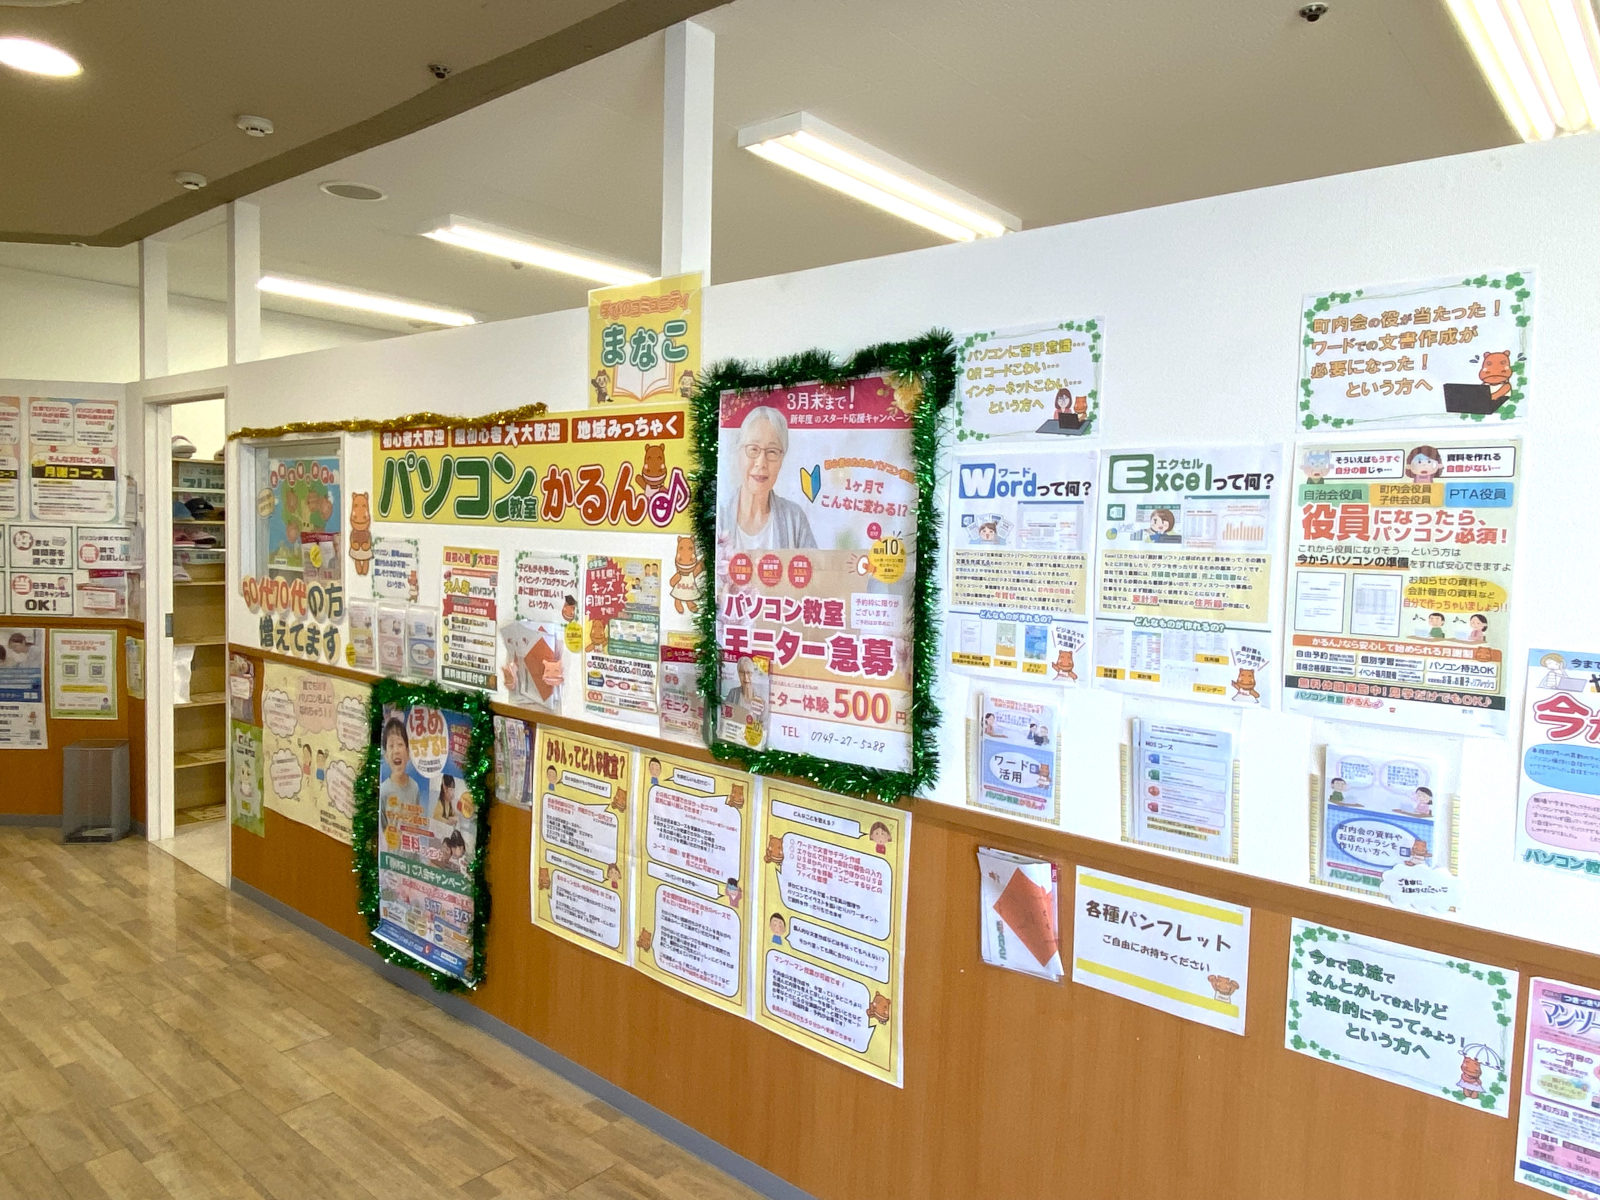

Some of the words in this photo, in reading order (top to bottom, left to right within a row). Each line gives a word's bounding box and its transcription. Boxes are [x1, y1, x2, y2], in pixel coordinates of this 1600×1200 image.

[1313, 299, 1501, 334] 町内会の役が当たった!
[601, 322, 688, 371] まなこ
[1311, 325, 1479, 356] ワードでの文書作成が
[967, 338, 1086, 362] パソコンに苦手意識…
[1310, 353, 1429, 379] 必要になった!
[966, 378, 1082, 398] インターネットこわい…
[1345, 378, 1433, 399] という方へ
[786, 385, 855, 411] 3月末まで!
[988, 398, 1045, 415] という方へ
[576, 415, 679, 441] 地域みっちゃく
[1157, 458, 1203, 470] エクセル
[1335, 454, 1401, 465] そういえばもうすぐ
[1446, 453, 1502, 462] 資料を作れる
[998, 467, 1031, 478] ワード
[378, 451, 537, 522] パソコン
[1303, 489, 1363, 501] 自治会役員
[1380, 484, 1432, 494] 町内会役員
[1449, 489, 1506, 501] PTA役員
[508, 495, 538, 521] 教室
[821, 494, 909, 518] こんなに変わる!?
[1380, 495, 1431, 505] 子供会役員
[1302, 504, 1370, 542] 役員
[1373, 509, 1490, 527] になったら、
[1373, 527, 1508, 545] パソコン必須!
[1298, 544, 1462, 557] これから役員になりそう…という方は
[1297, 554, 1511, 572] 今からパソコンの準備をすれば安心できますよ
[592, 578, 616, 595] キッズ
[1408, 576, 1488, 588] お知らせの資料や
[242, 577, 344, 620] 60代70代の方
[1407, 587, 1496, 600] 会計報告の資料など
[25, 599, 57, 611] OK!
[528, 600, 555, 610] という方へ
[724, 595, 844, 628] パソコン教室
[855, 599, 899, 608] 予約枠に限りが
[1403, 598, 1509, 613] 自分で作っちゃいましょう!!
[855, 609, 890, 617] ございます。
[979, 609, 1053, 624] どんなものが作れるの?
[1134, 617, 1225, 632] どんなものが作れるの?
[259, 616, 339, 660] 増えてます
[725, 628, 895, 678] モニター急募
[1296, 650, 1329, 660] 自由予約
[1360, 655, 1395, 666] 個別学習
[1429, 661, 1495, 675] パソコン持込OK
[833, 688, 891, 724] 500
[895, 711, 907, 726] 円
[409, 708, 443, 737] ほめ
[781, 725, 800, 738] TEL
[810, 731, 886, 753] 0749-27-5288
[546, 738, 625, 780] かるんってどんな教室?
[994, 755, 1029, 772] ワード
[999, 767, 1022, 784] 活用
[1338, 823, 1403, 841] 町内会の資料や
[1338, 833, 1398, 851] お店のチラシを
[1338, 843, 1391, 858] 作りたい方へ
[1085, 899, 1232, 952] 各種パンフレット
[1102, 934, 1211, 972] ご自由にお持ちください
[1308, 948, 1396, 984] 今まで我流で
[1307, 970, 1449, 1021] なんとかしてきたけど
[1305, 990, 1466, 1048] 本格的にやってみよう!
[1345, 1022, 1431, 1060] という方へ
[1536, 1043, 1594, 1065] レッスン内容の
[1555, 1055, 1574, 1068] 一例
[1533, 1101, 1570, 1118] 予約方法
[1576, 1155, 1591, 1165] なし
